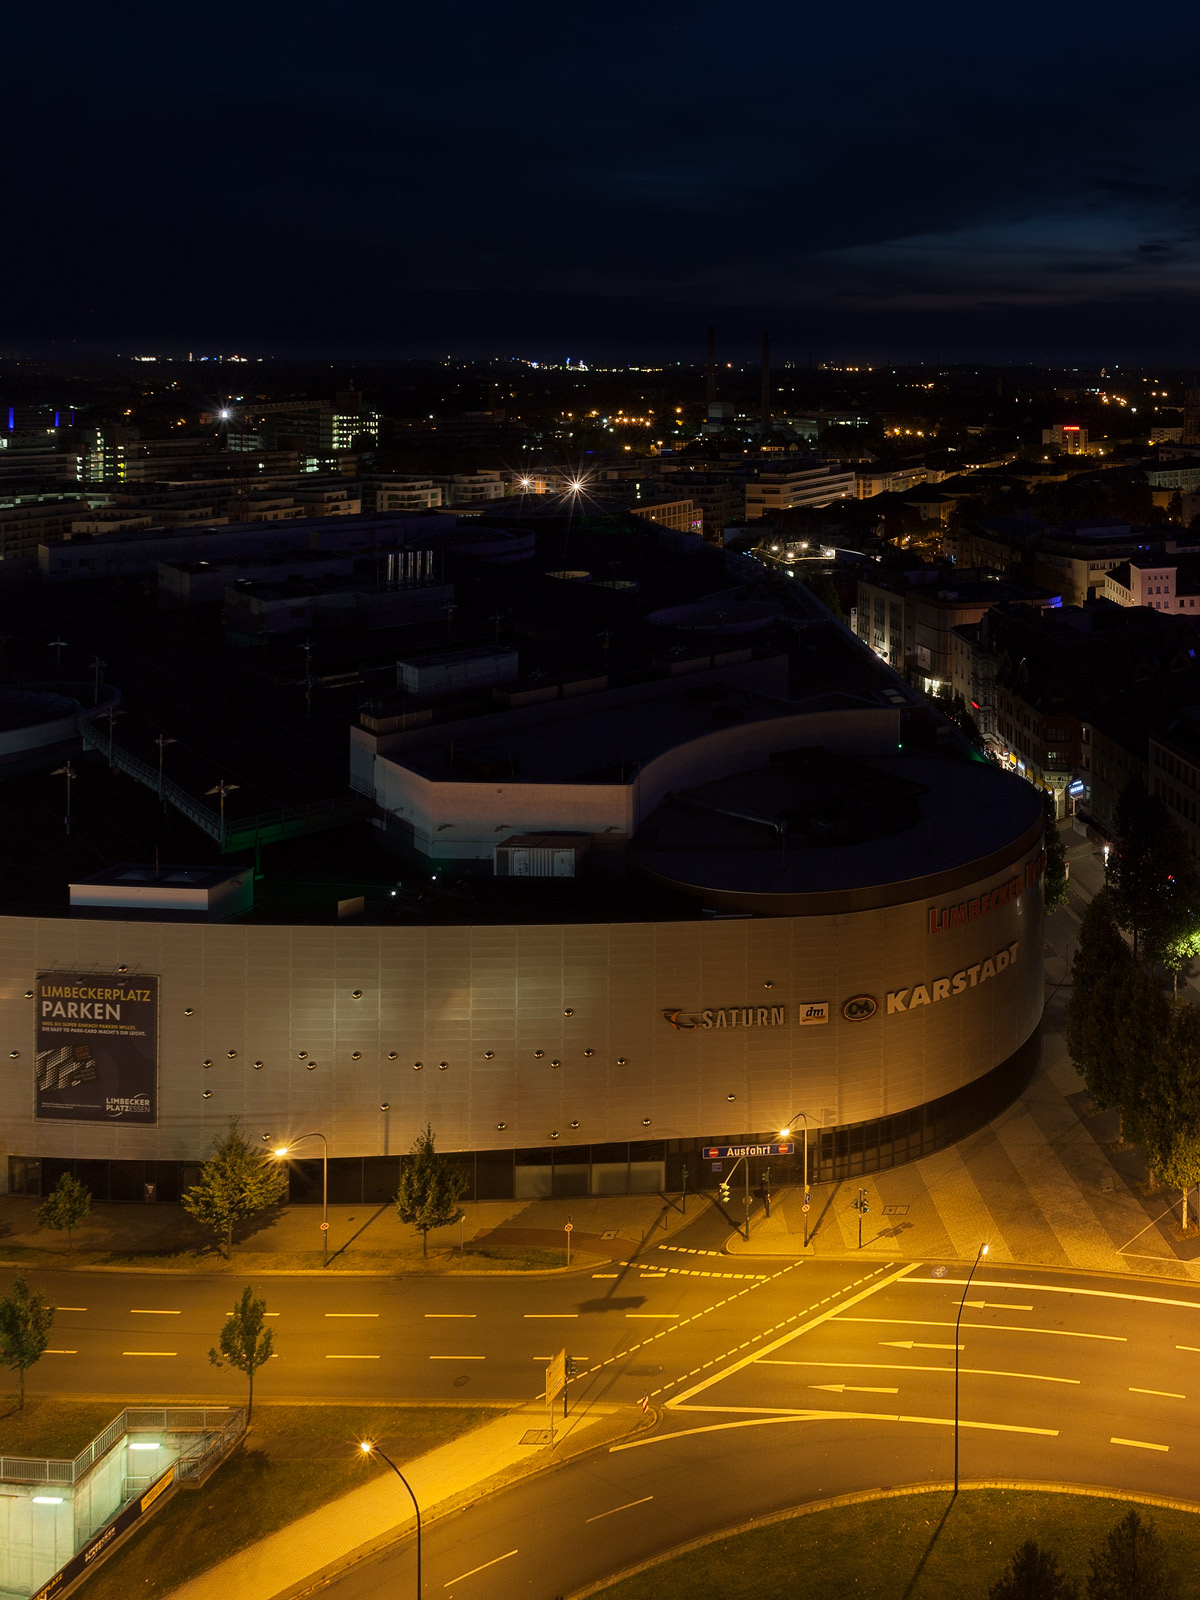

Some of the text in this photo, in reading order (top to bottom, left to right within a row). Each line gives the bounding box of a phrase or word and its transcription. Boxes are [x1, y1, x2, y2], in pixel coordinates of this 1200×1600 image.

[886, 941, 1019, 1014] KARSTADT
[41, 986, 151, 1001] LIMBECKERPLATZ
[42, 1001, 121, 1020] PARKEN
[702, 1005, 785, 1029] SATURN
[806, 1007, 823, 1017] dm
[106, 1097, 150, 1106] LIMBECKER
[727, 1146, 771, 1157] Ausfahrt
